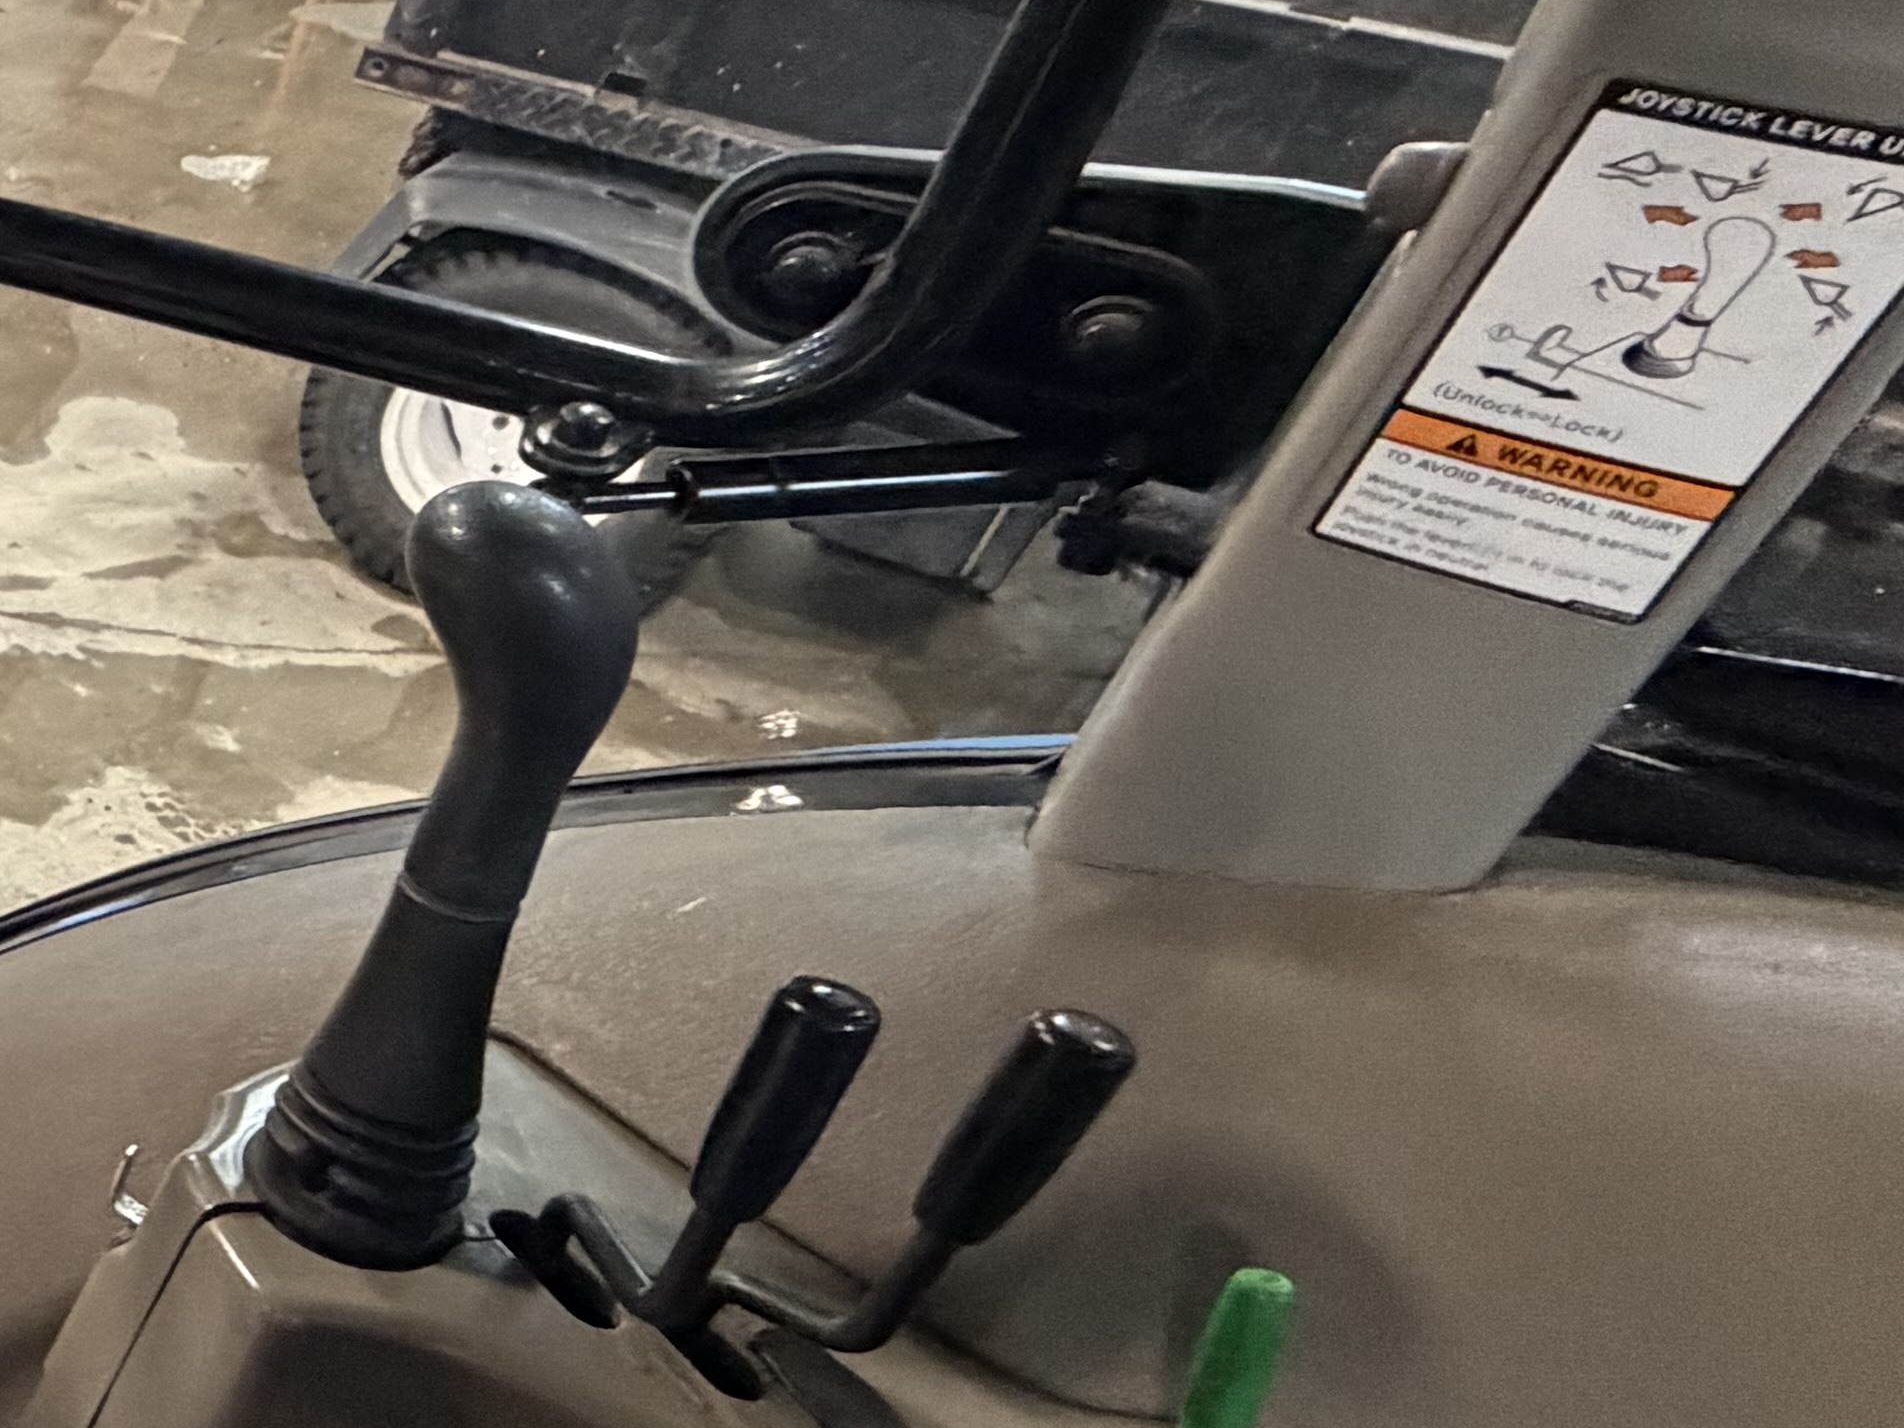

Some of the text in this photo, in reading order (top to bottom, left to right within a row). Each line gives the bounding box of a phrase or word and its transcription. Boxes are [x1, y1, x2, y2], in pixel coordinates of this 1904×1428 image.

[1618, 87, 1904, 157] JOYSTICK LEVER U
[1386, 448, 1689, 536] TO AVOID PERSONAL INJURY
[1496, 443, 1662, 499] WARNING
